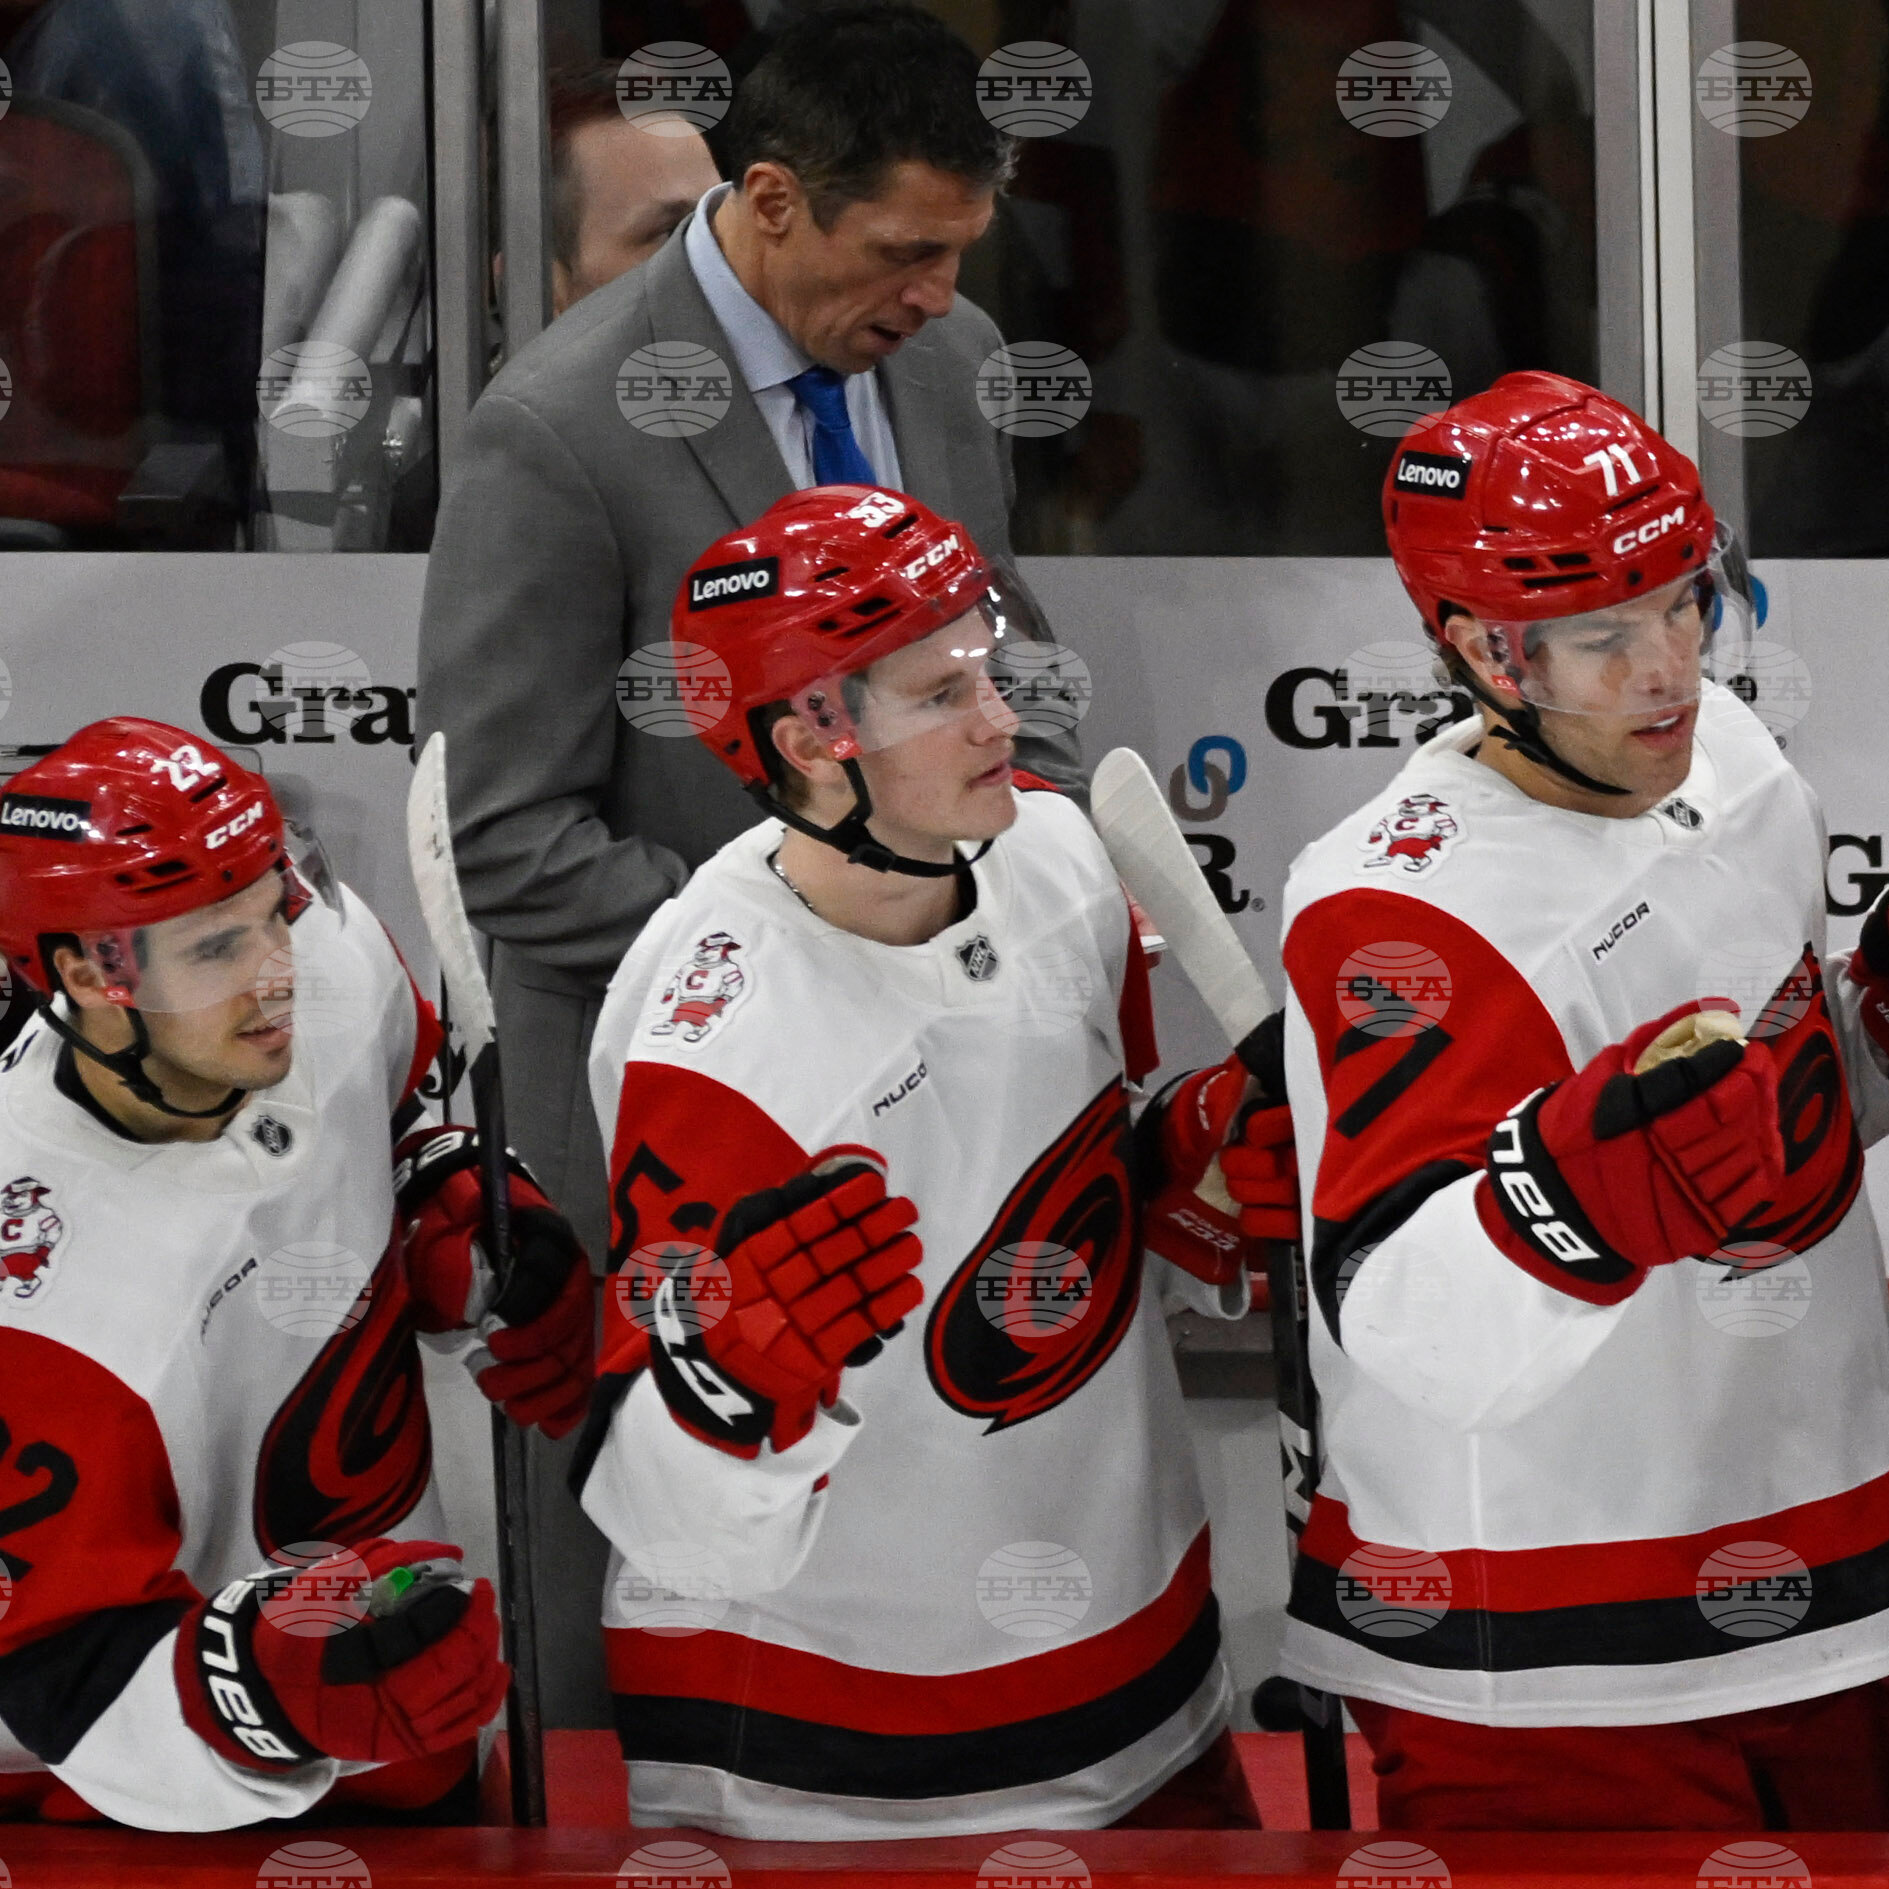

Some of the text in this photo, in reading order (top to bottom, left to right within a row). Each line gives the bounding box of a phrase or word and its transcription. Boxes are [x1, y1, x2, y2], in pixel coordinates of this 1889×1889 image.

[1397, 458, 1460, 489] Lenovo
[1583, 443, 1641, 496] 71
[849, 492, 905, 527] 53
[1613, 506, 1684, 553] CCM
[905, 533, 958, 579] CCM
[693, 571, 769, 601] Lenovo
[150, 744, 221, 792] 22
[1, 802, 79, 832] Lenovo
[204, 800, 263, 849] CCM
[1592, 902, 1650, 960] NUCOR
[872, 1062, 928, 1117] NUCO
